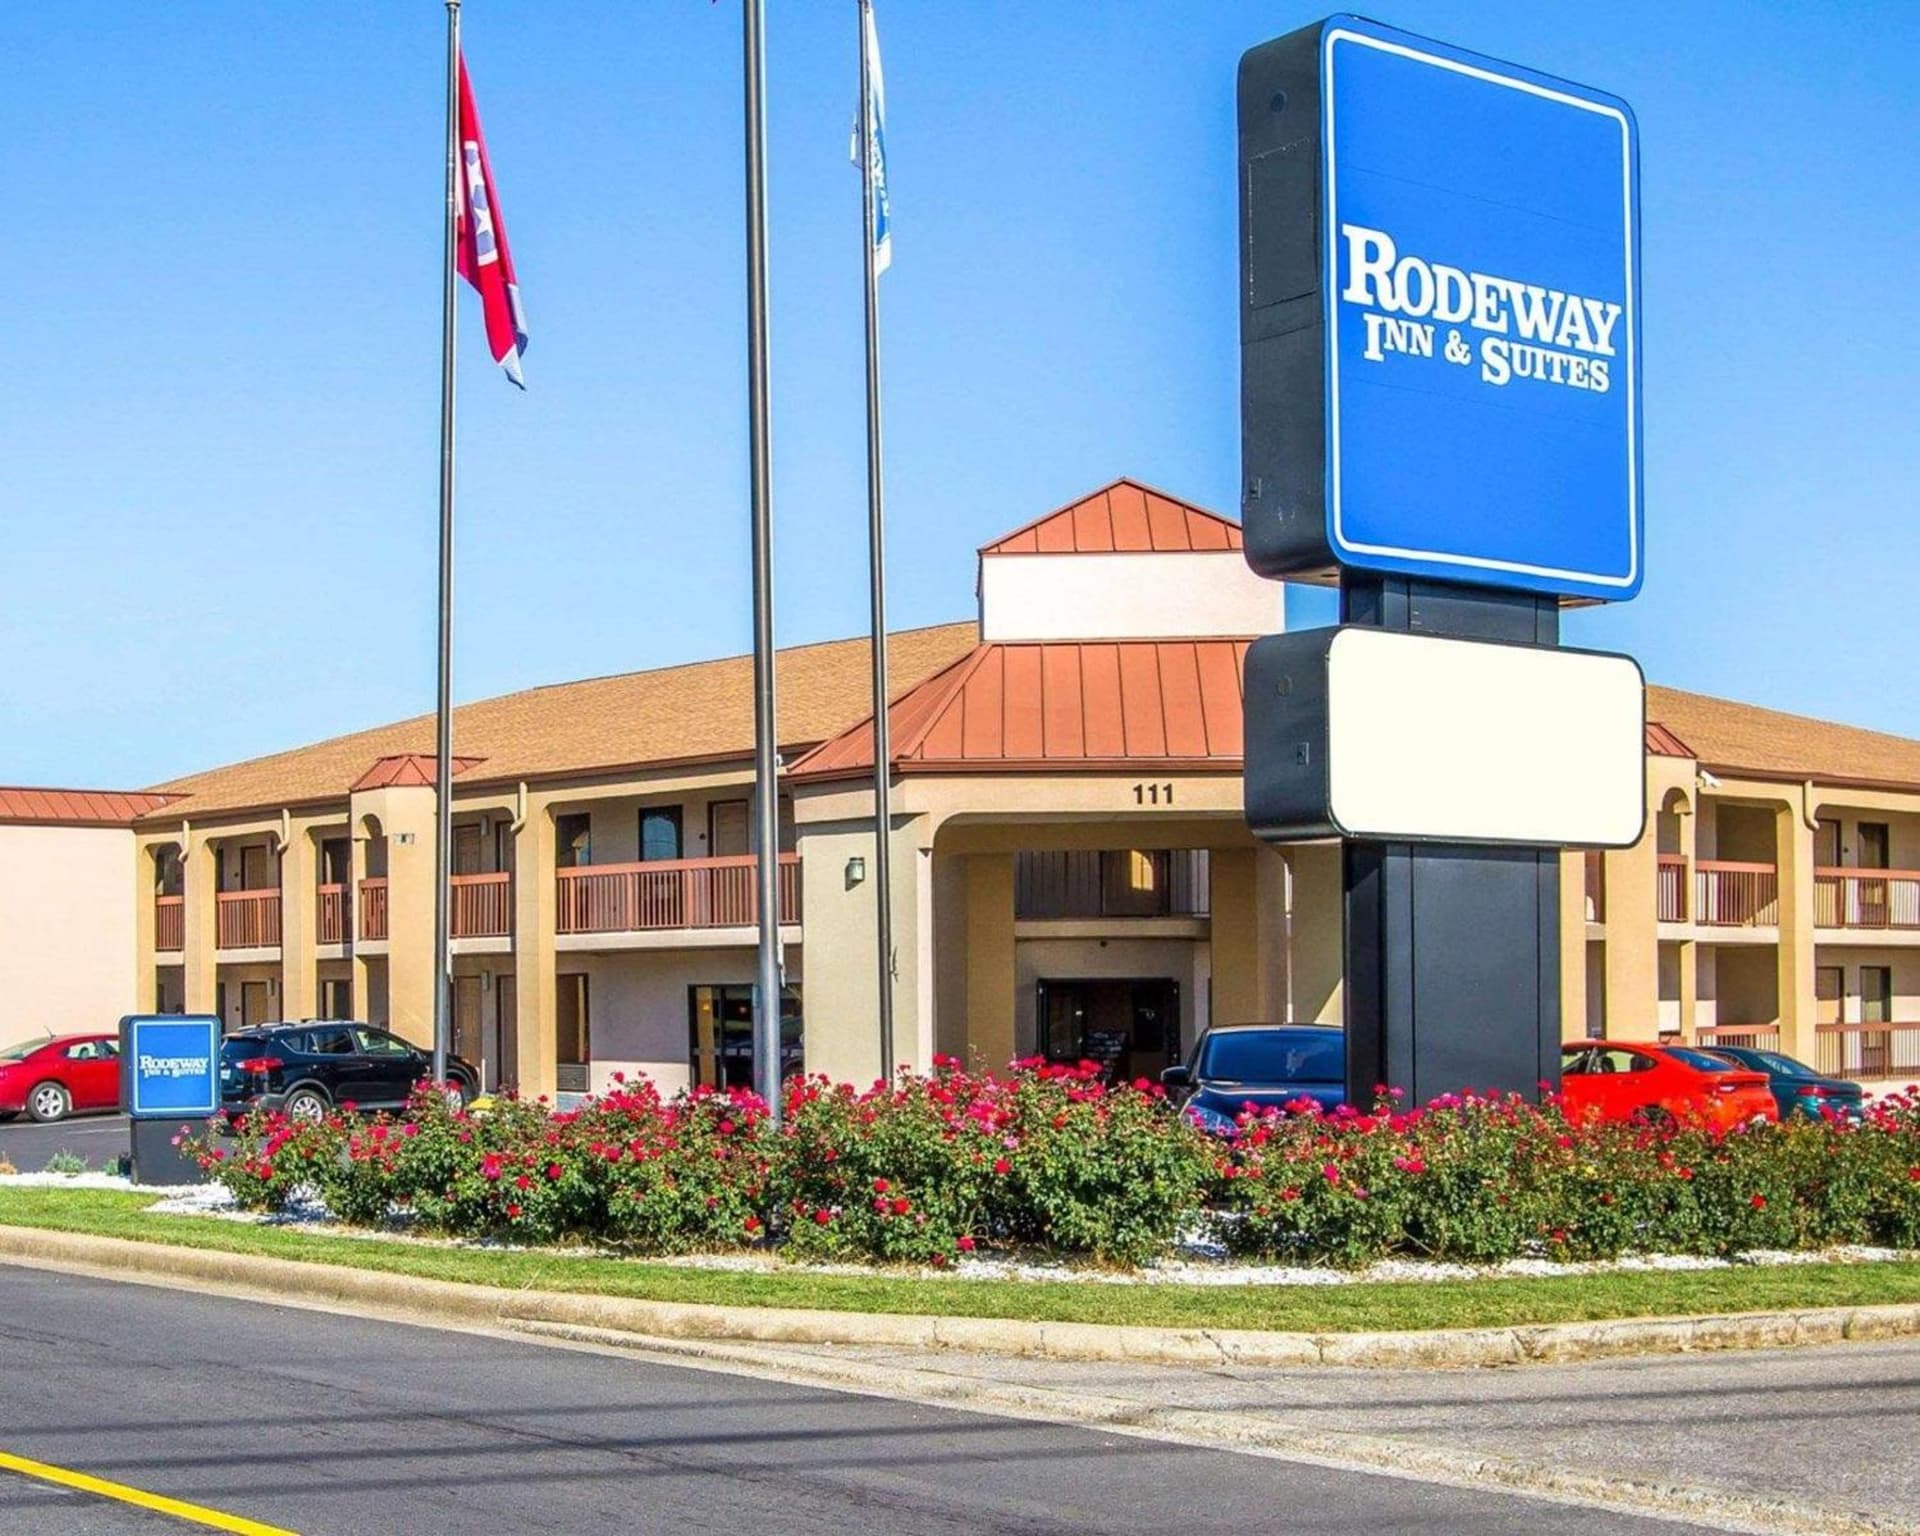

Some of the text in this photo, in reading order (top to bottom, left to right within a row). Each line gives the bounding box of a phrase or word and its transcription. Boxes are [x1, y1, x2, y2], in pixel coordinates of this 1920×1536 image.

[1342, 223, 1622, 356] RODEWAY
[1363, 312, 1611, 393] INN & SUITES
[1133, 783, 1173, 805] 111
